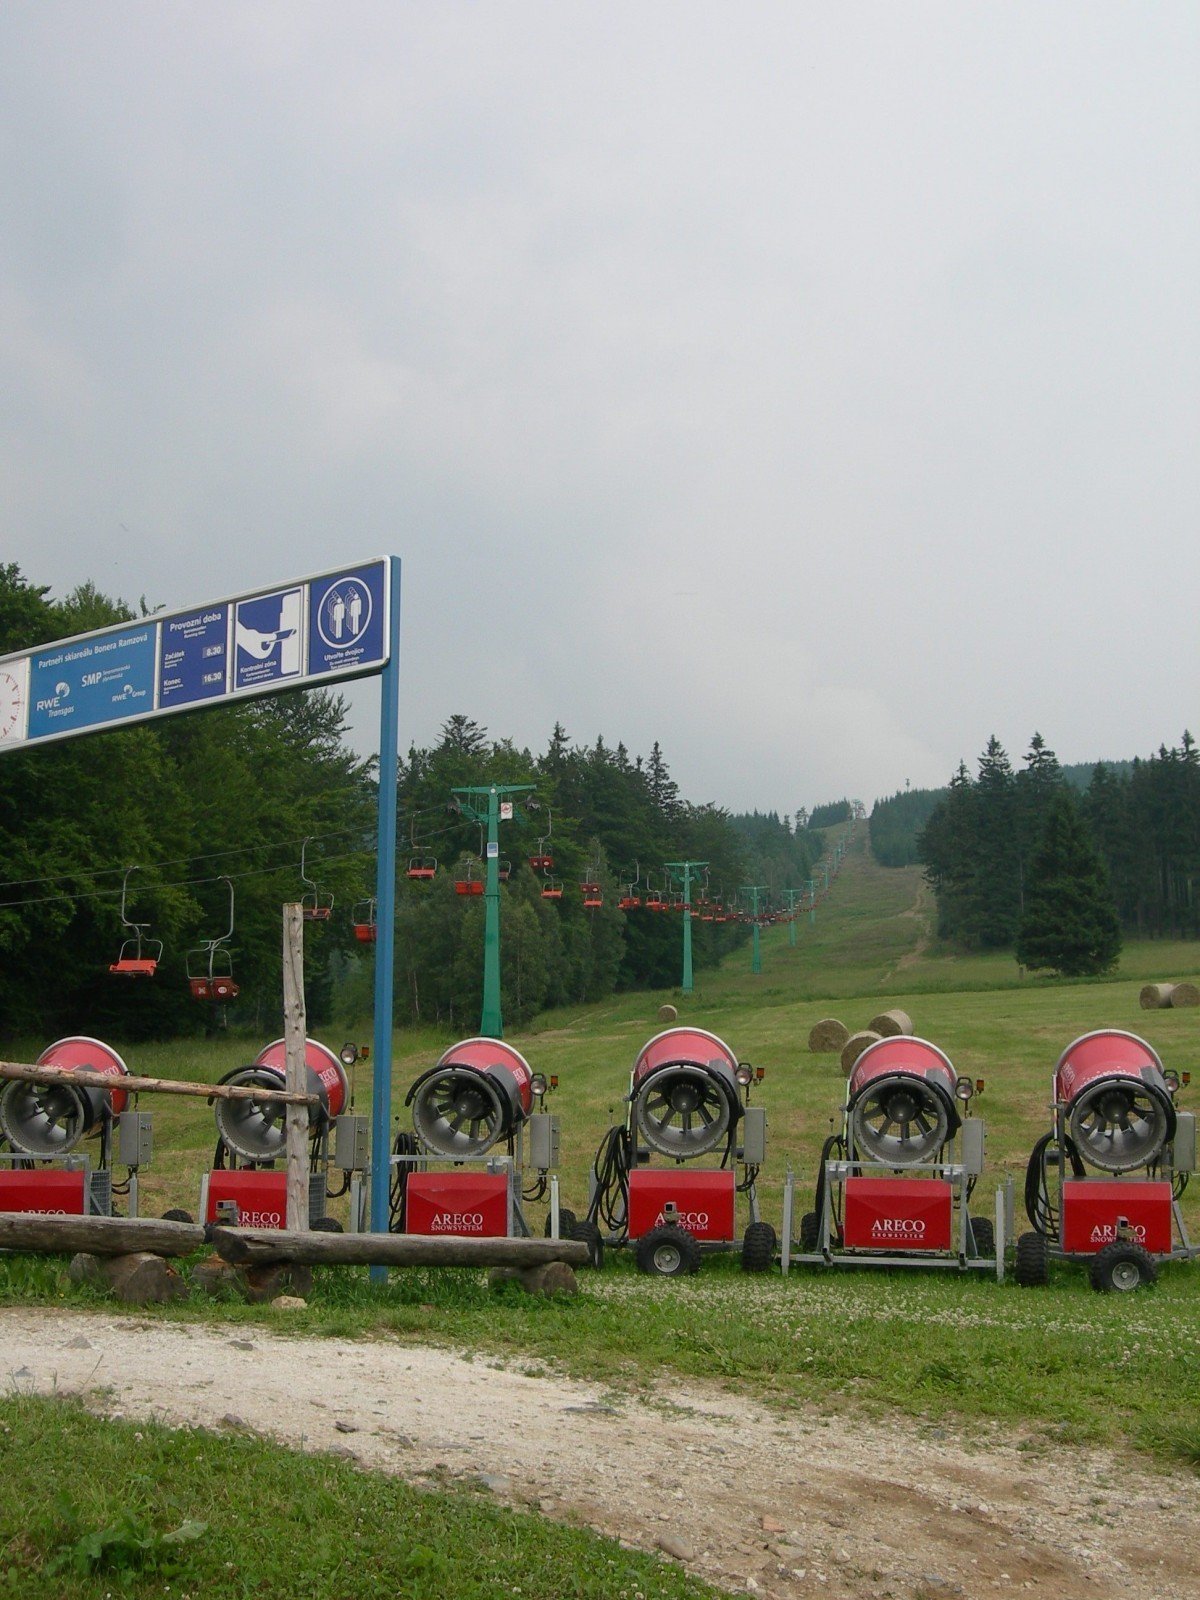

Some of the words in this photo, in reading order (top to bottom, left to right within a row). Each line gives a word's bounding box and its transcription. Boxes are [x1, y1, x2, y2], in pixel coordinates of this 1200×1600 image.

[169, 615, 202, 632] Provozní
[202, 612, 222, 624] doba
[38, 655, 64, 669] Partneři
[94, 641, 117, 655] Bonera
[118, 633, 148, 648] Ramzová
[81, 671, 102, 688] SMP
[163, 678, 181, 687] Konec
[203, 671, 222, 683] 16.30
[36, 696, 60, 712] RWE
[111, 693, 127, 702] RWE
[48, 705, 75, 718] Transgas
[431, 1213, 484, 1226] ARECO
[654, 1211, 709, 1225] AECO
[430, 1224, 483, 1232] SNOWSYSTEM
[871, 1219, 926, 1232] ARECO
